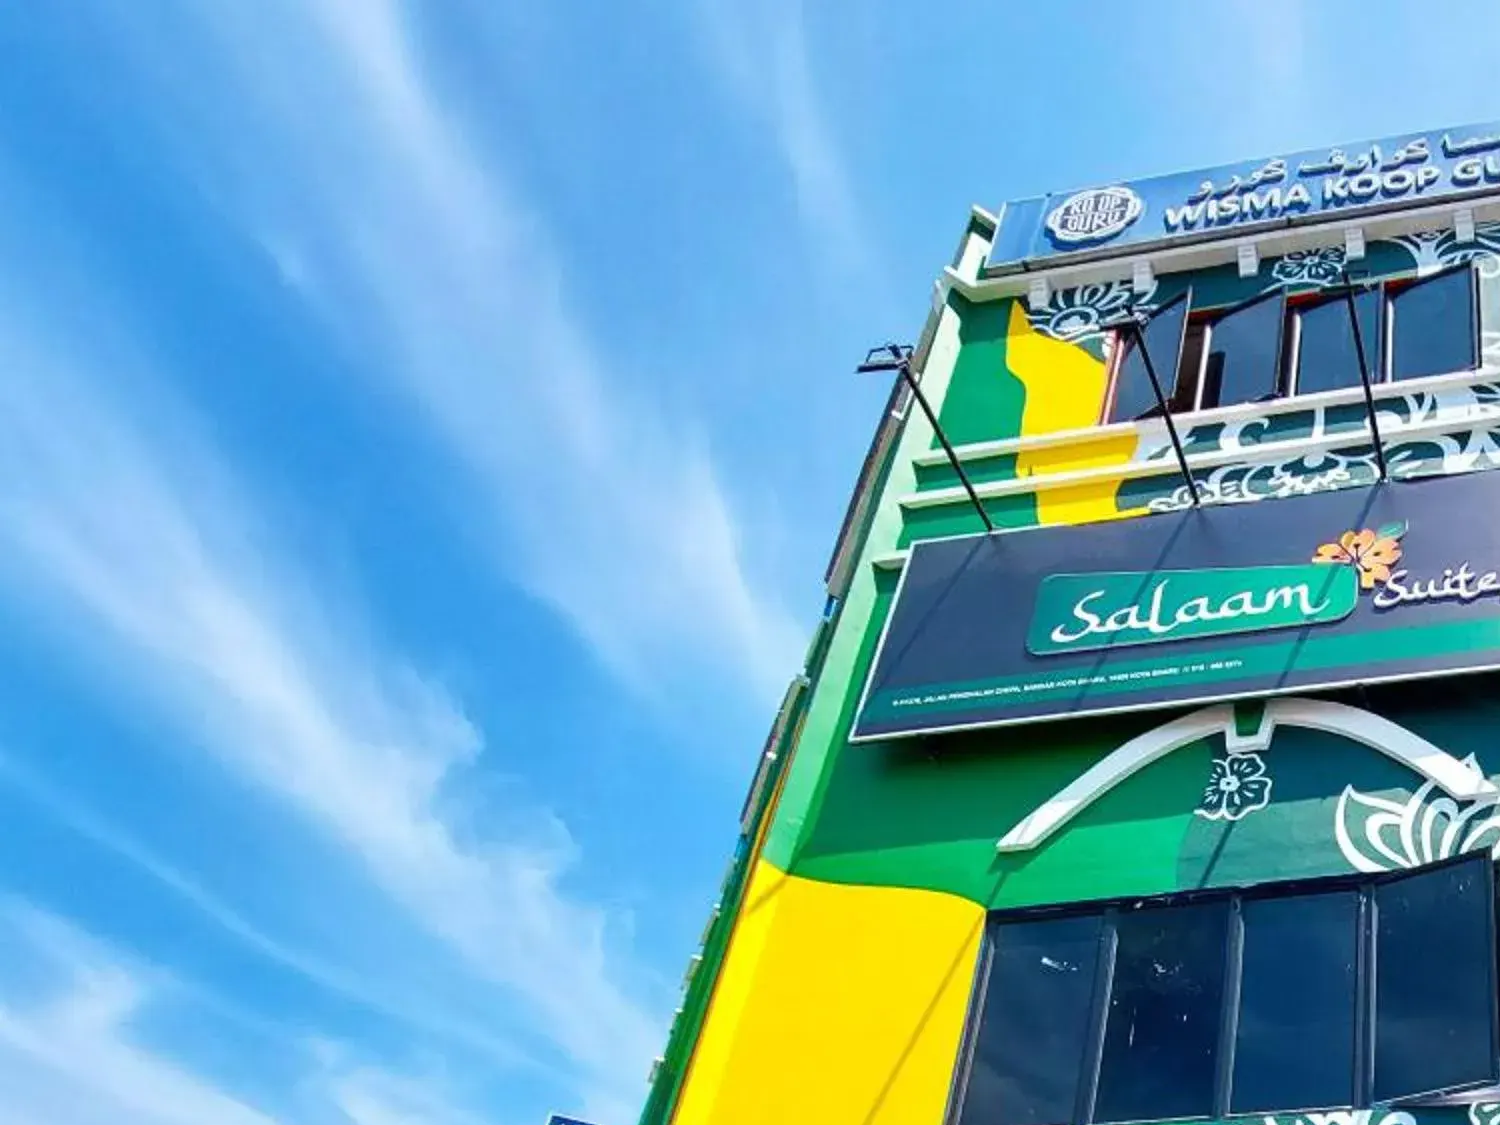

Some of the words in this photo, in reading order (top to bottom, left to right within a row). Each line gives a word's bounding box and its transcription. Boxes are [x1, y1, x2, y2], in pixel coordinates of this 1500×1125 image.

[1163, 183, 1310, 231] WISMA
[1322, 165, 1441, 203] KOOP
[1051, 579, 1331, 643] Salaam
